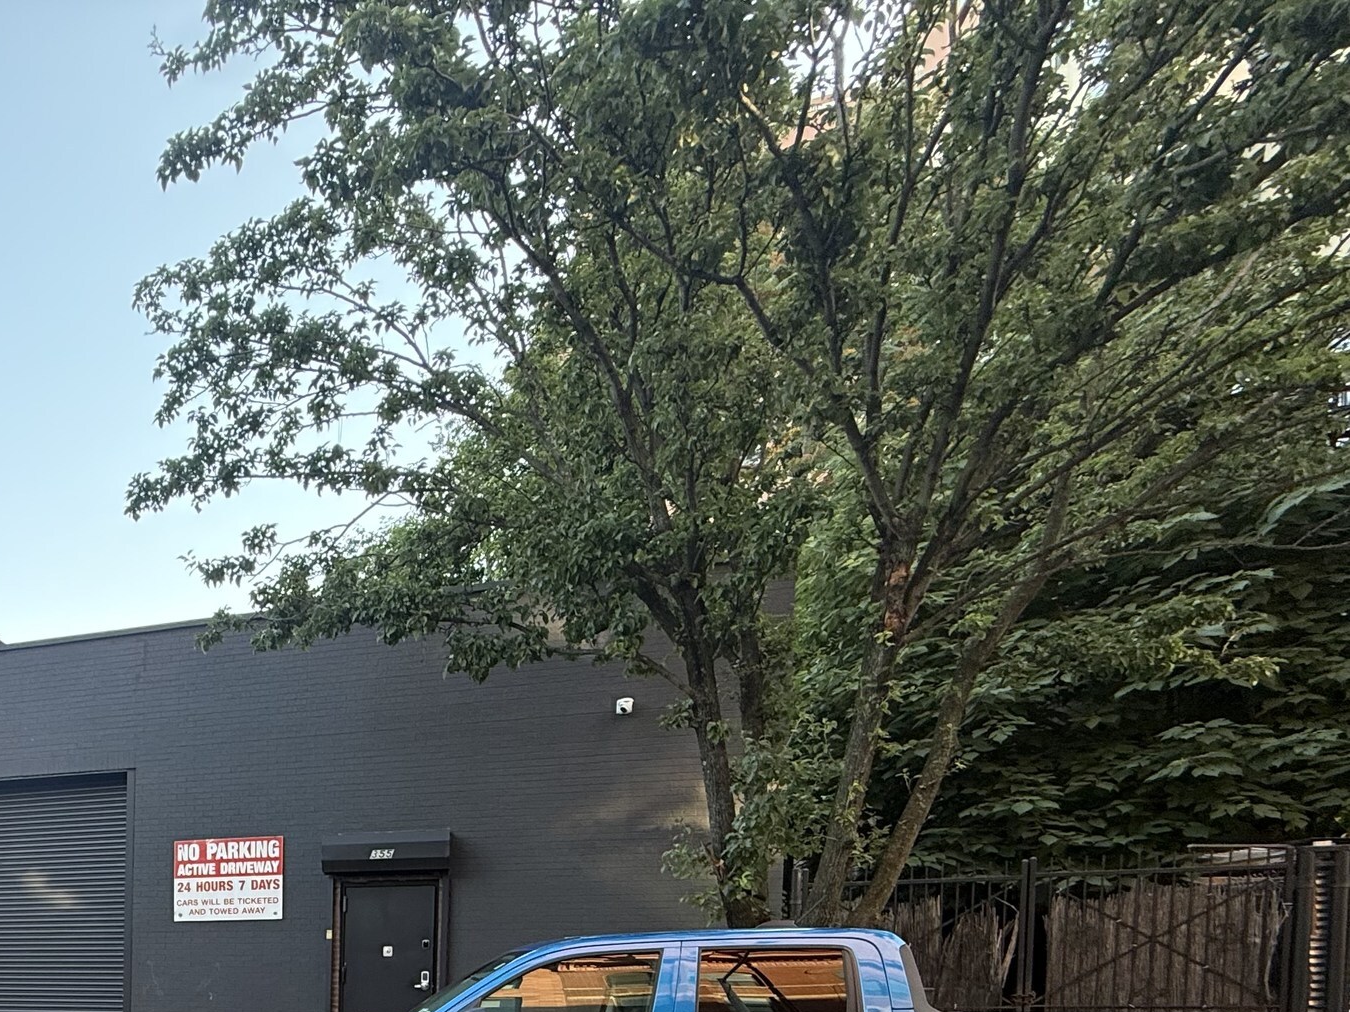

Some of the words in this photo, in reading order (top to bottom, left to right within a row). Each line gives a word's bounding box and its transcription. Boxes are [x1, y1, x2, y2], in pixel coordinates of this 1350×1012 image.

[177, 844, 199, 861] NO
[206, 840, 279, 860] PARKING
[370, 849, 394, 859] 355
[177, 863, 215, 876] ACTIVE
[220, 860, 279, 875] DRIVEWAY
[177, 882, 191, 893] 24
[196, 880, 233, 892] HOURS
[238, 880, 245, 891] 7
[251, 879, 280, 890] DAYS
[177, 899, 198, 907] CARS
[238, 897, 279, 905] TICKETED
[189, 908, 206, 916] AND
[209, 907, 239, 915] TOWED
